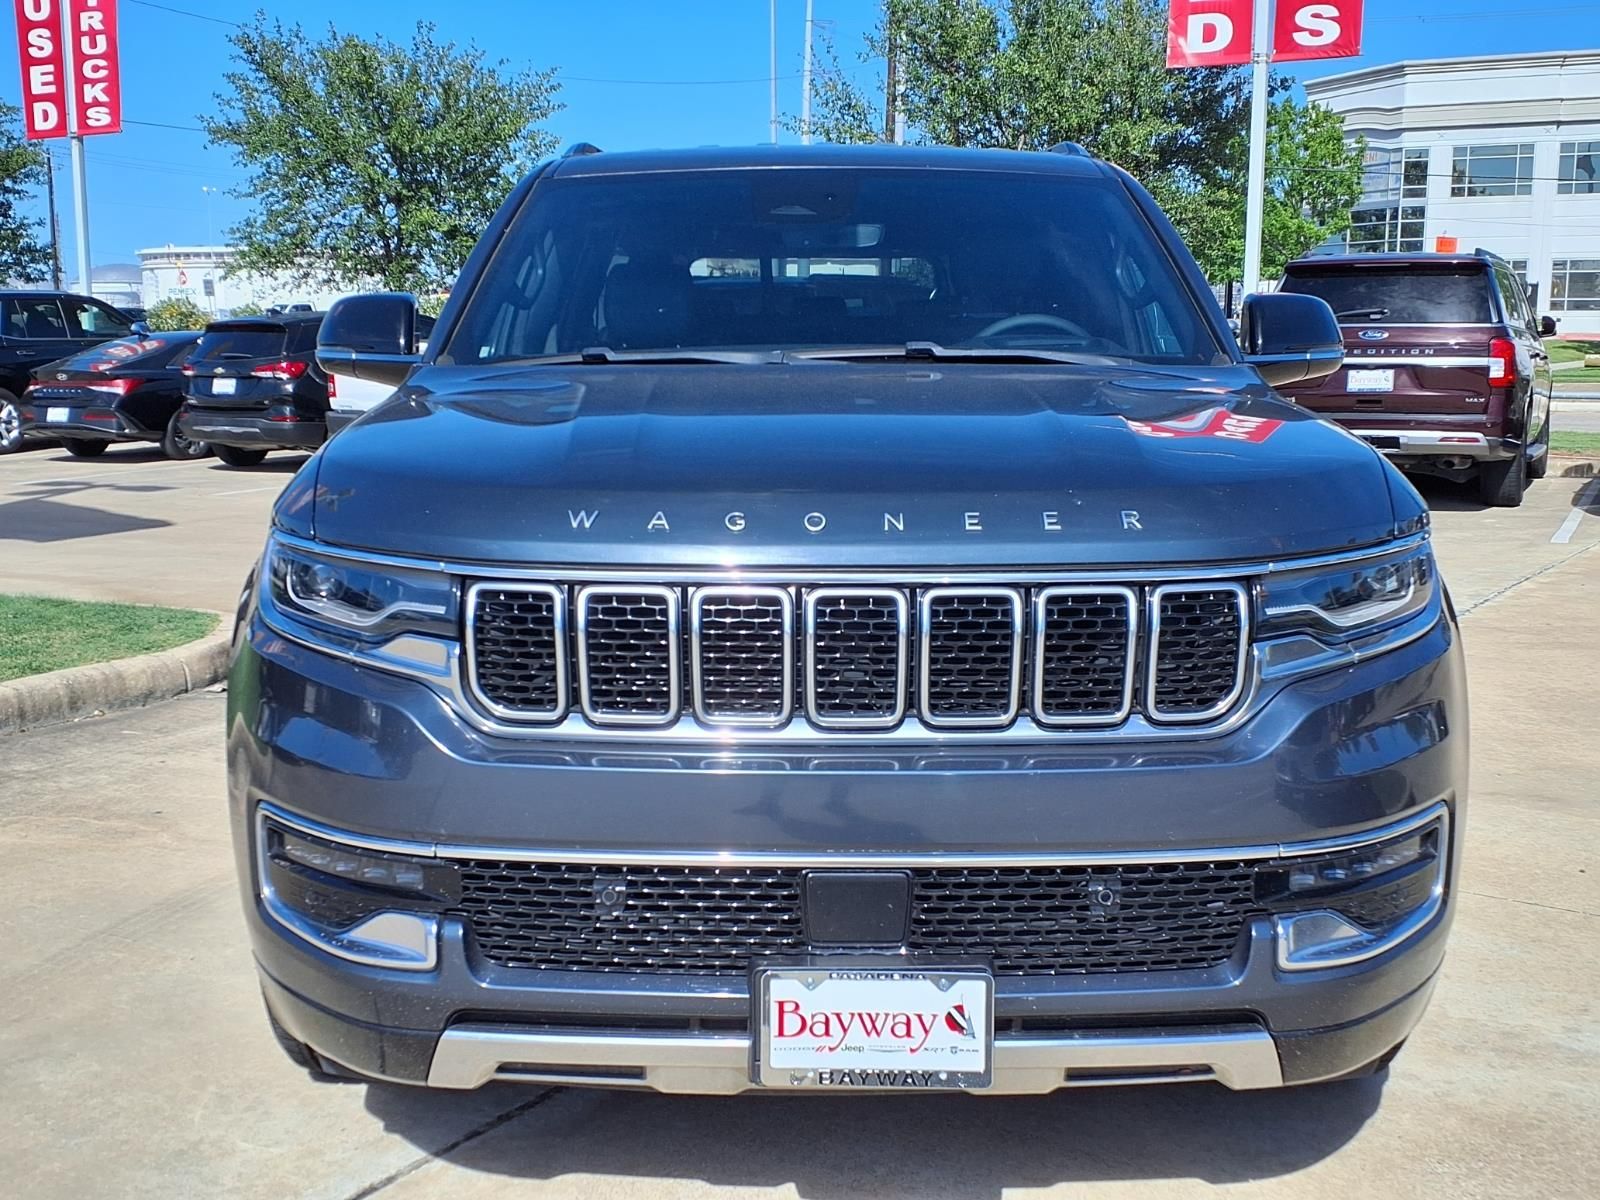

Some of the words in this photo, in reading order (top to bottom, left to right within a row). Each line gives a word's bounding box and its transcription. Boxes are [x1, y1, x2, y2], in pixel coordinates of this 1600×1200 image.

[24, 0, 58, 131] USED
[568, 509, 1143, 532] WAGONEER
[774, 1000, 938, 1054] Bayway
[841, 1044, 865, 1054] Jeep
[818, 1071, 934, 1086] BAYWAY
